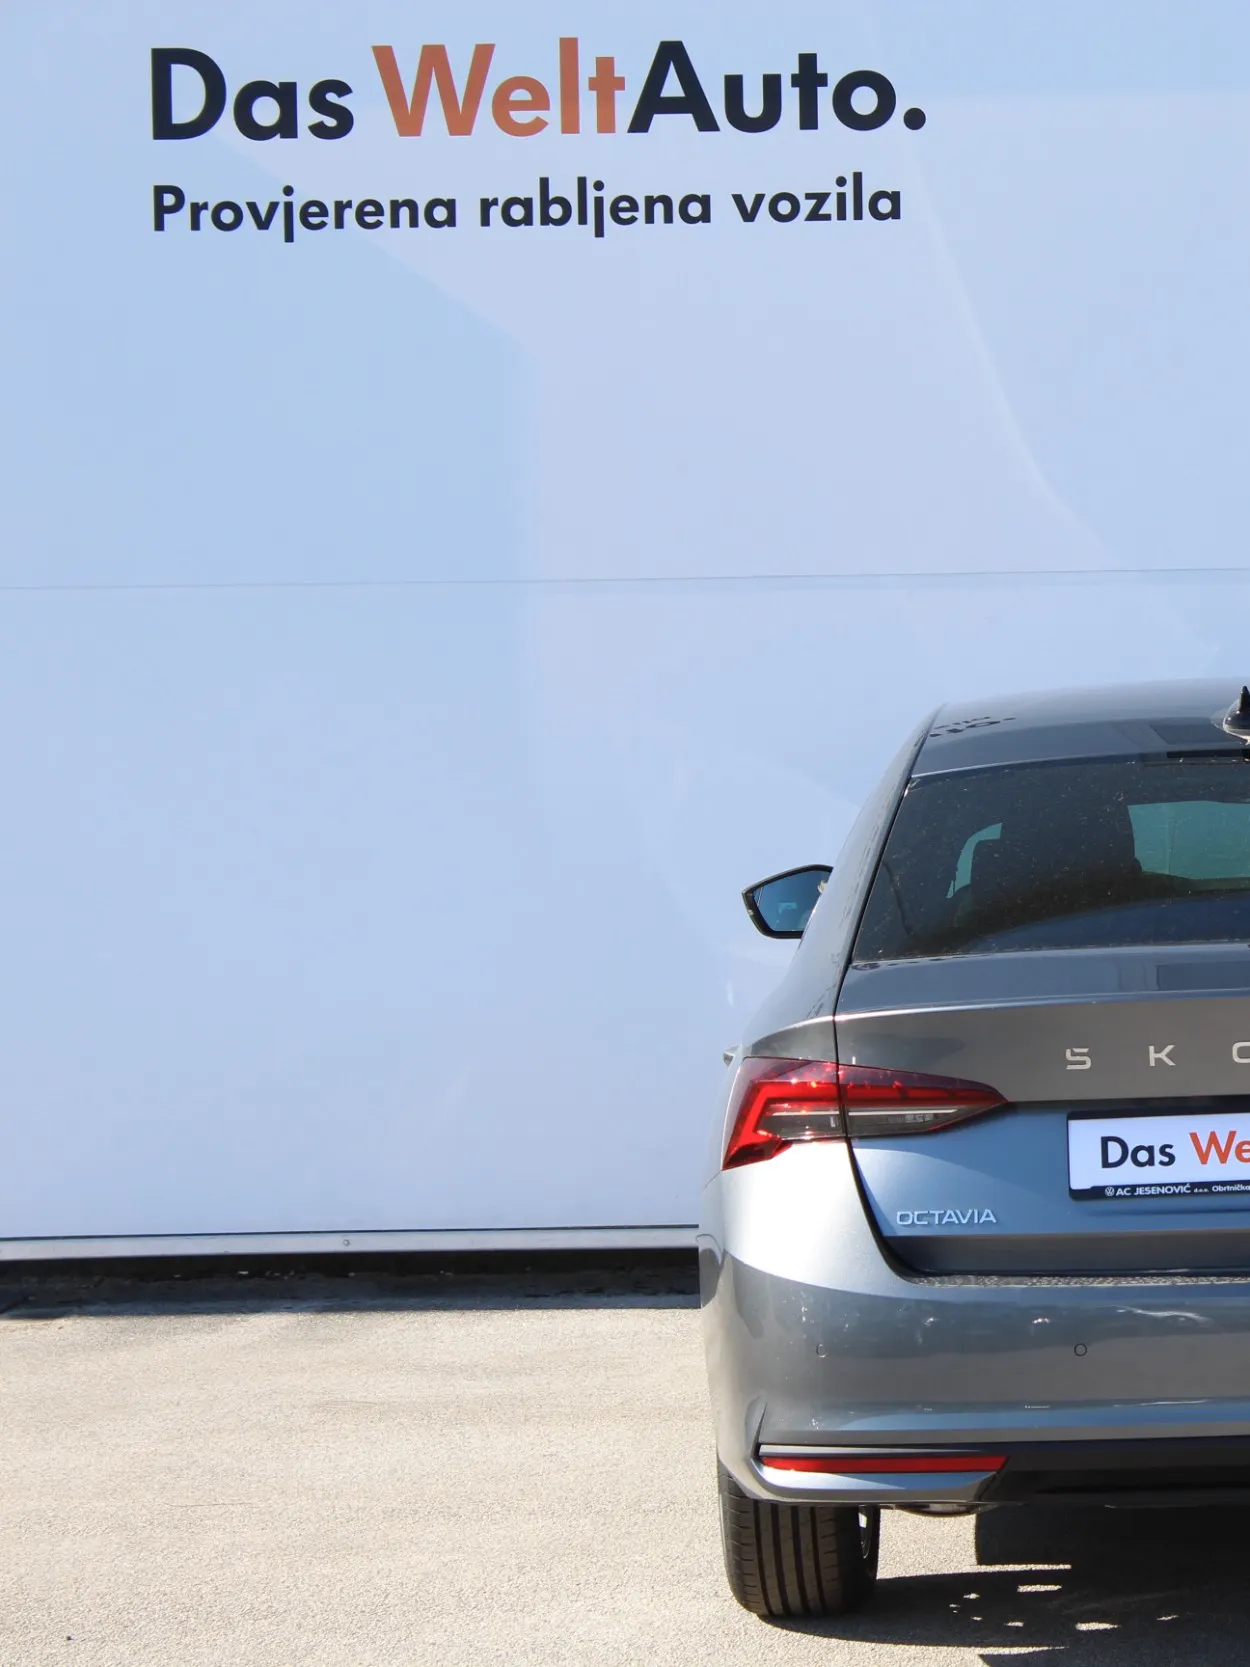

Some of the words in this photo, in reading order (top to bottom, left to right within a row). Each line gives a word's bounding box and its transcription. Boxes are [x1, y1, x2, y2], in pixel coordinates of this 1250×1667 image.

[150, 47, 354, 142] Das
[371, 37, 927, 137] WeltAuto.
[153, 184, 457, 243] Provjerena
[479, 176, 711, 238] rabljena
[731, 171, 901, 223] vozila
[1100, 1135, 1176, 1169] Das
[1115, 1187, 1132, 1196] AC
[1133, 1183, 1191, 1196] JESENOVIĆ
[1211, 1184, 1250, 1192] Obrtnička
[896, 1208, 997, 1225] OCTAVIA
